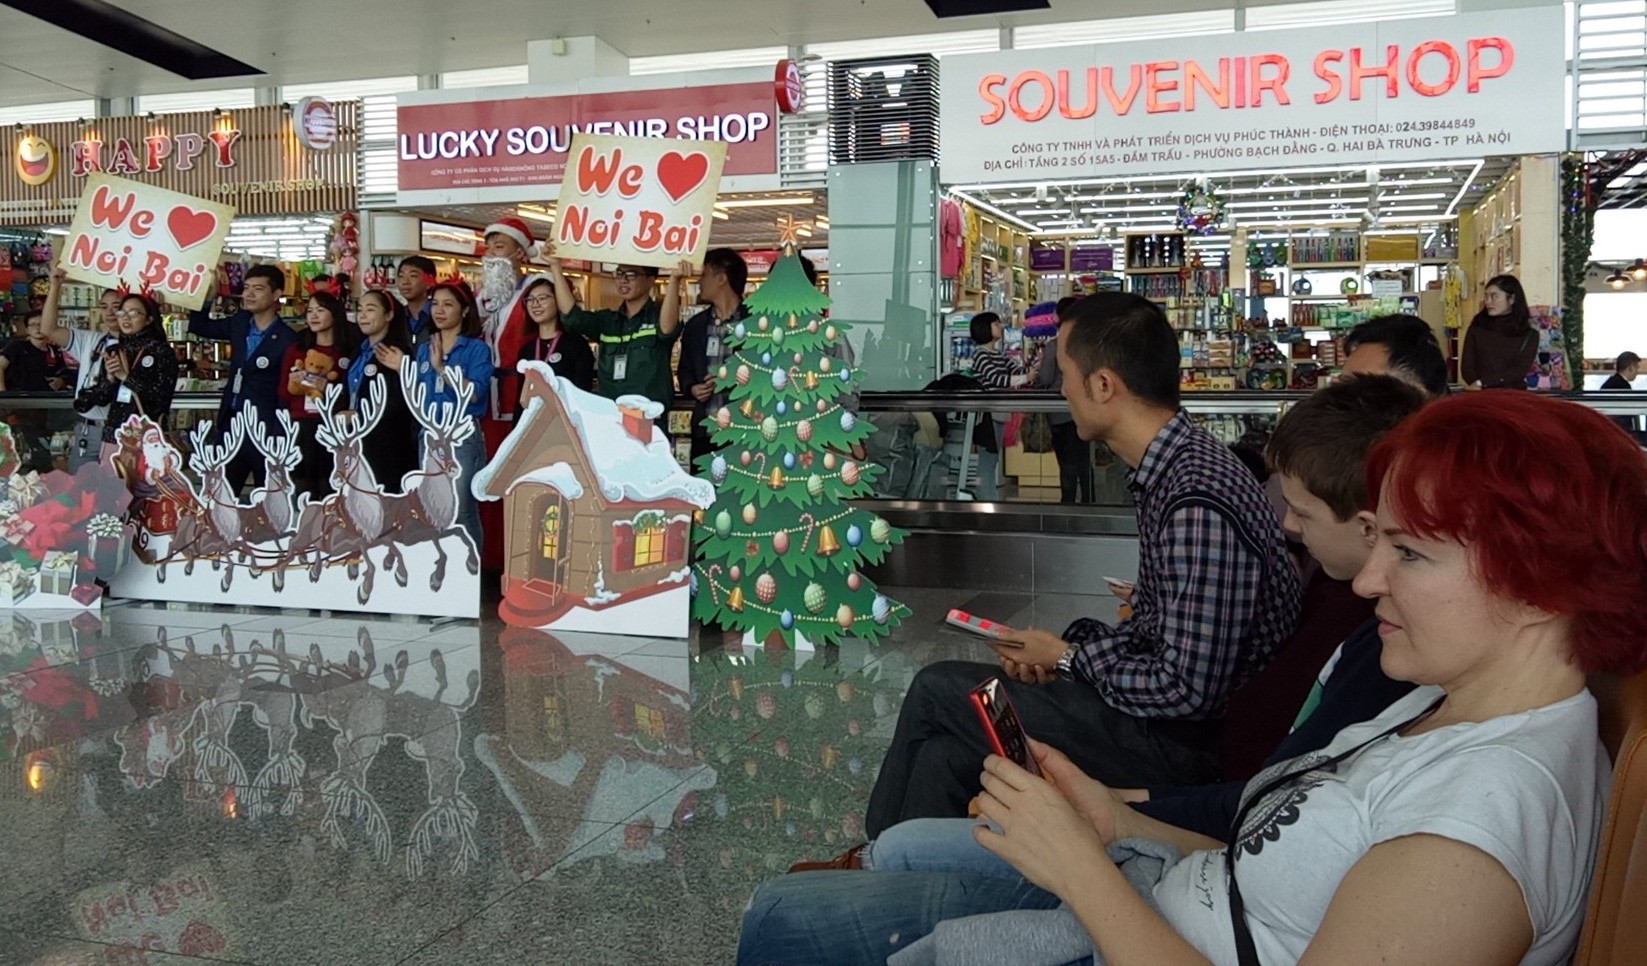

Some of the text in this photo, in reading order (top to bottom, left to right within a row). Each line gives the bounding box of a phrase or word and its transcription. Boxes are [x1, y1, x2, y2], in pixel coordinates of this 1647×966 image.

[978, 37, 1517, 125] SOUVENIR SHOP
[71, 129, 242, 177] HAPPY
[401, 128, 500, 160] LUCKY
[676, 111, 769, 143] SHOP
[984, 160, 1001, 172] ĐỊA
[1062, 157, 1068, 166] 2
[1070, 152, 1086, 166] SỐ
[1089, 154, 1115, 165] 15A5
[1246, 146, 1279, 159] BẠCH
[1343, 141, 1364, 152] HAI
[1367, 138, 1384, 150] BÀ
[1388, 137, 1432, 149] TRƯNG
[1443, 135, 1459, 147] TP
[1466, 132, 1484, 145] HÀ
[1488, 129, 1511, 143] NỘI
[1012, 140, 1043, 154] CÔNG
[1046, 142, 1059, 152] TY
[1063, 140, 1092, 151] TNHH
[1095, 137, 1110, 149] VÀ
[1113, 136, 1143, 148] PHÁT
[1148, 131, 1180, 146] TRIỂN
[1184, 133, 1211, 146] DỊCH
[1215, 132, 1230, 145] VỤ
[1234, 129, 1265, 141] PHÚC
[1269, 126, 1310, 139] THÀNH
[1320, 124, 1348, 137] ĐIỆN
[1396, 118, 1476, 132] 024.39844849
[212, 178, 323, 196] SOUVENIR SHOP
[576, 144, 644, 198] We
[89, 185, 155, 238] We
[559, 204, 703, 255] Noi Bai
[68, 232, 206, 296] Noi Bai
